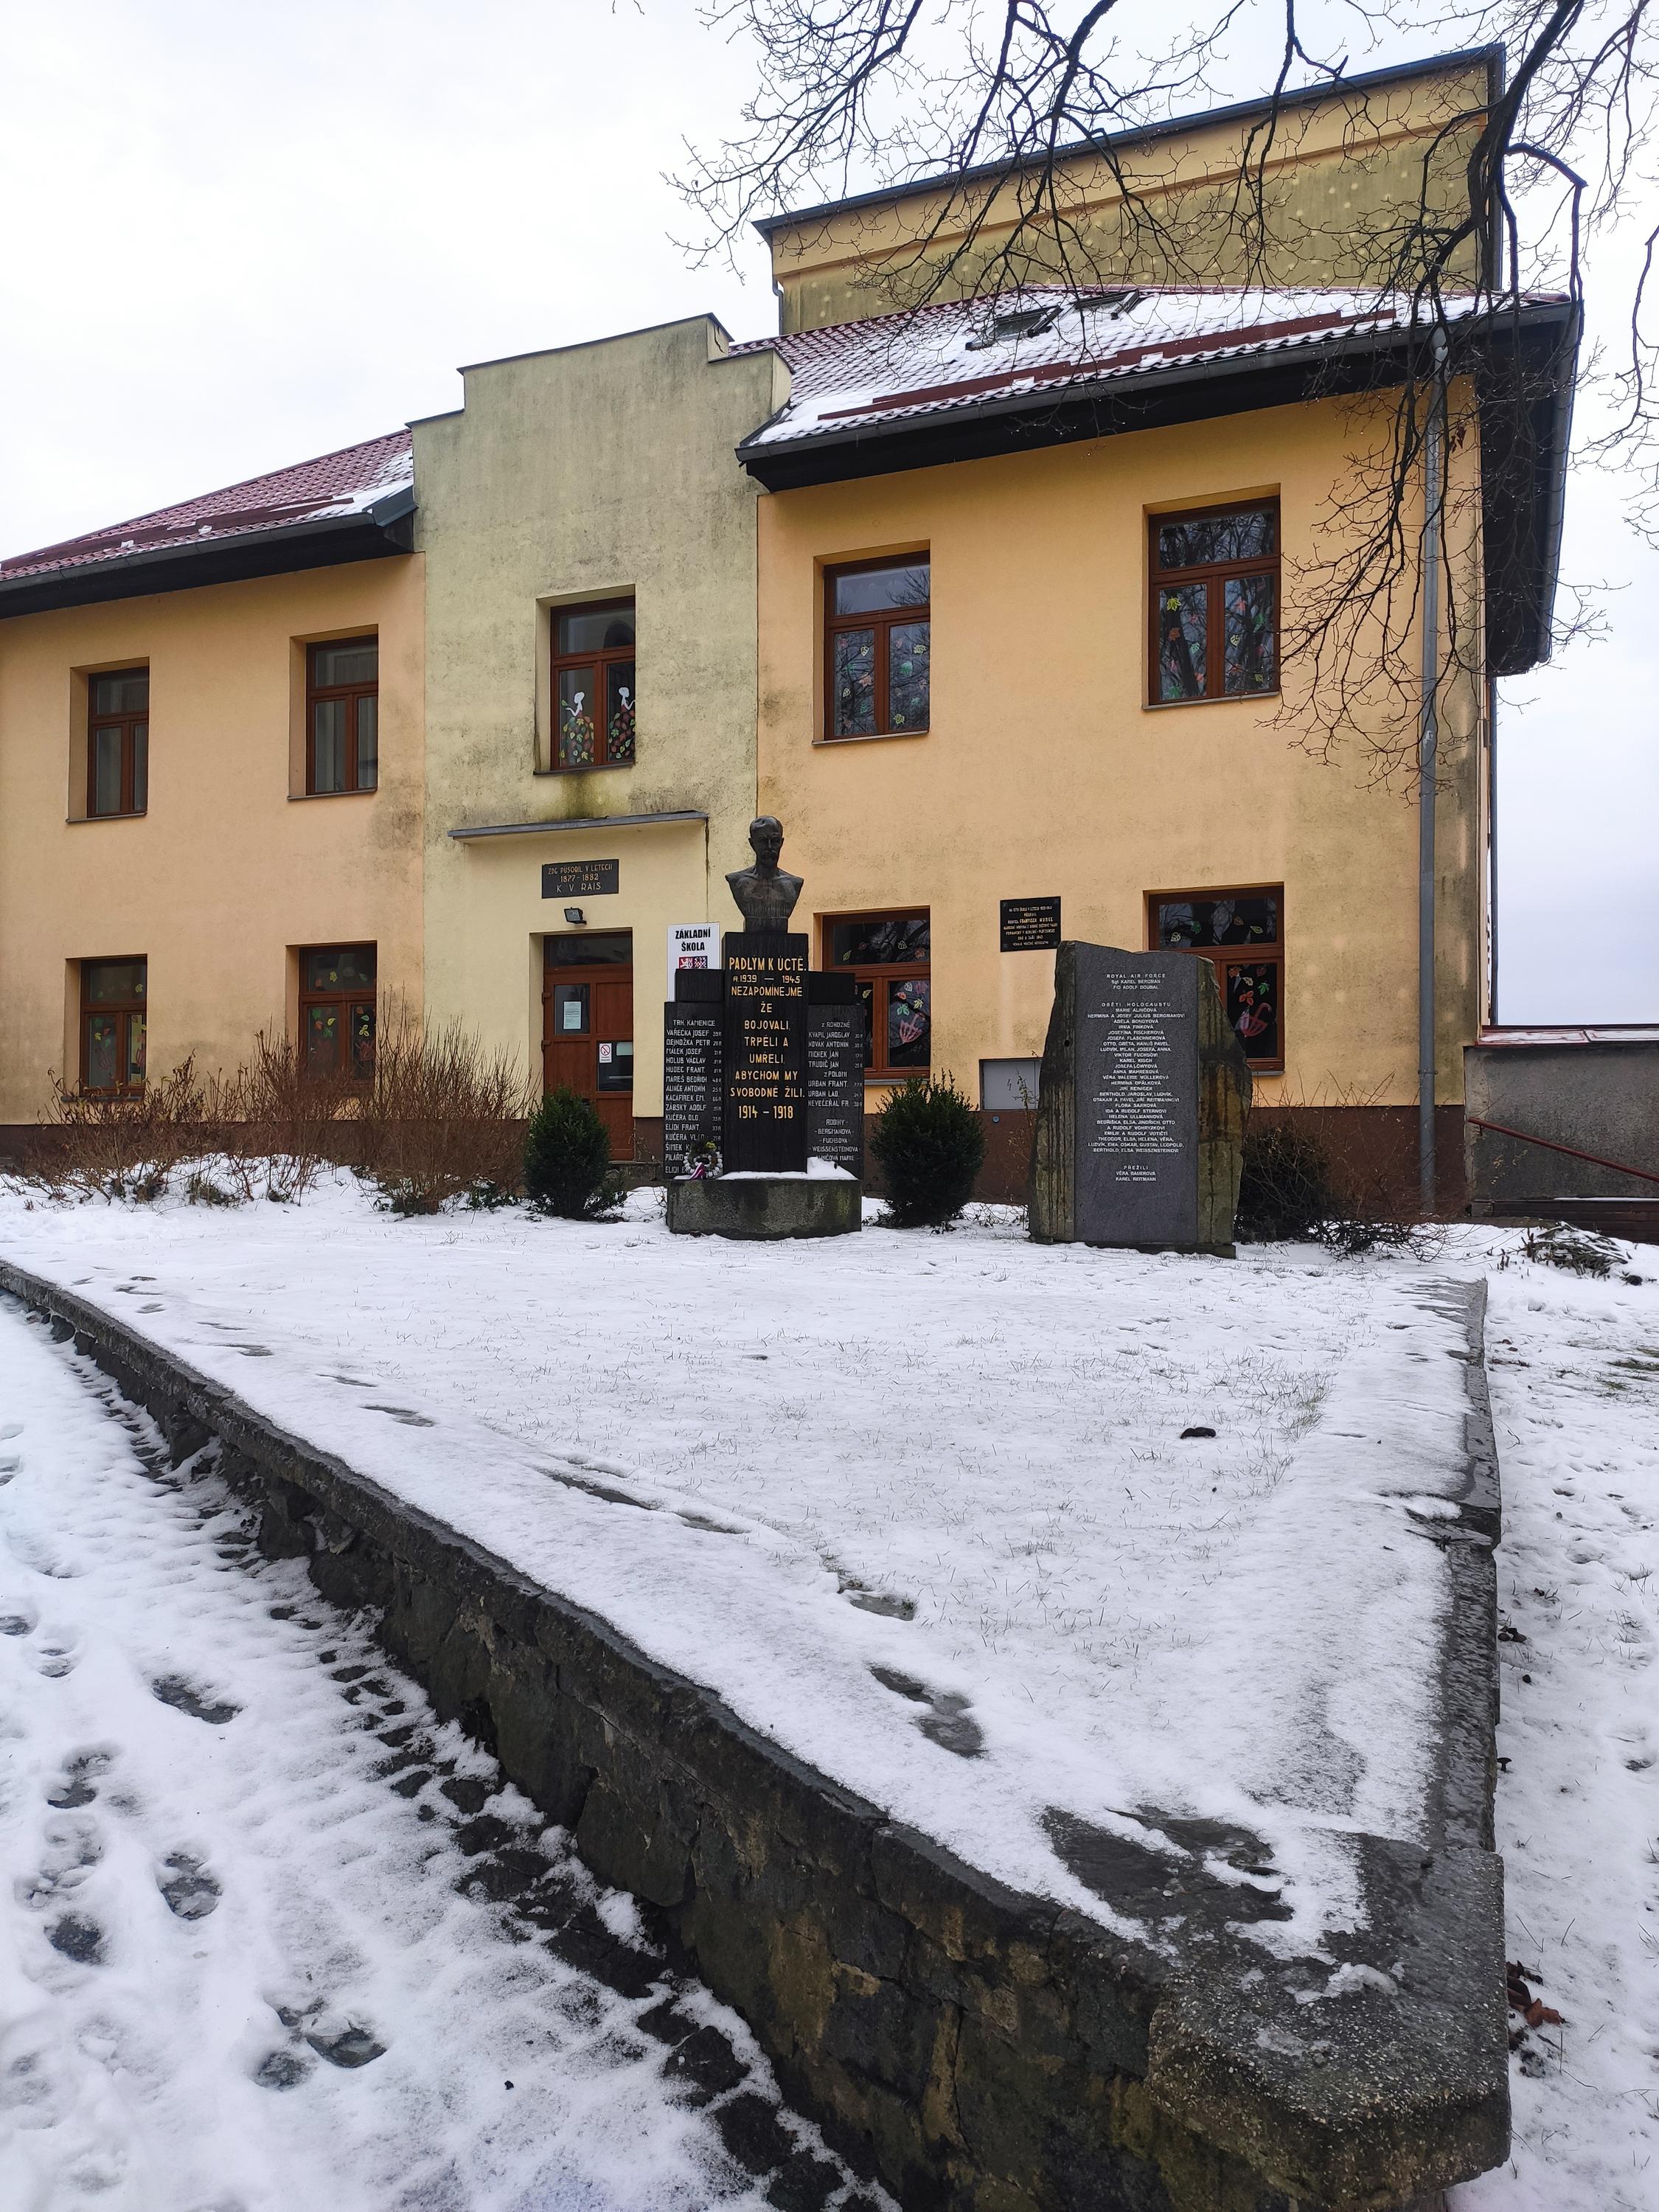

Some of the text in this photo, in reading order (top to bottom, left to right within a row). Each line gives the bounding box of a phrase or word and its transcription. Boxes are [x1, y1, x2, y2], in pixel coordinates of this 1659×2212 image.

[591, 863, 613, 872] LETECH
[581, 883, 601, 891] RAIS
[675, 928, 711, 939] ZÁKLADNÍ
[681, 942, 705, 951] ŠKOLA
[729, 955, 806, 971] PADLÝM K ÚCTĚ.
[761, 1001, 772, 1012] ŽE
[745, 1034, 788, 1046] TRPĚLI A
[735, 1071, 798, 1080] ABYCHOM MY
[785, 1086, 805, 1097] ŽILI.
[666, 1113, 686, 1121] KUČERA
[739, 1106, 793, 1119] 1914 1918
[666, 1133, 686, 1141] KUČERA
[666, 1142, 682, 1150] ŠIMEK
